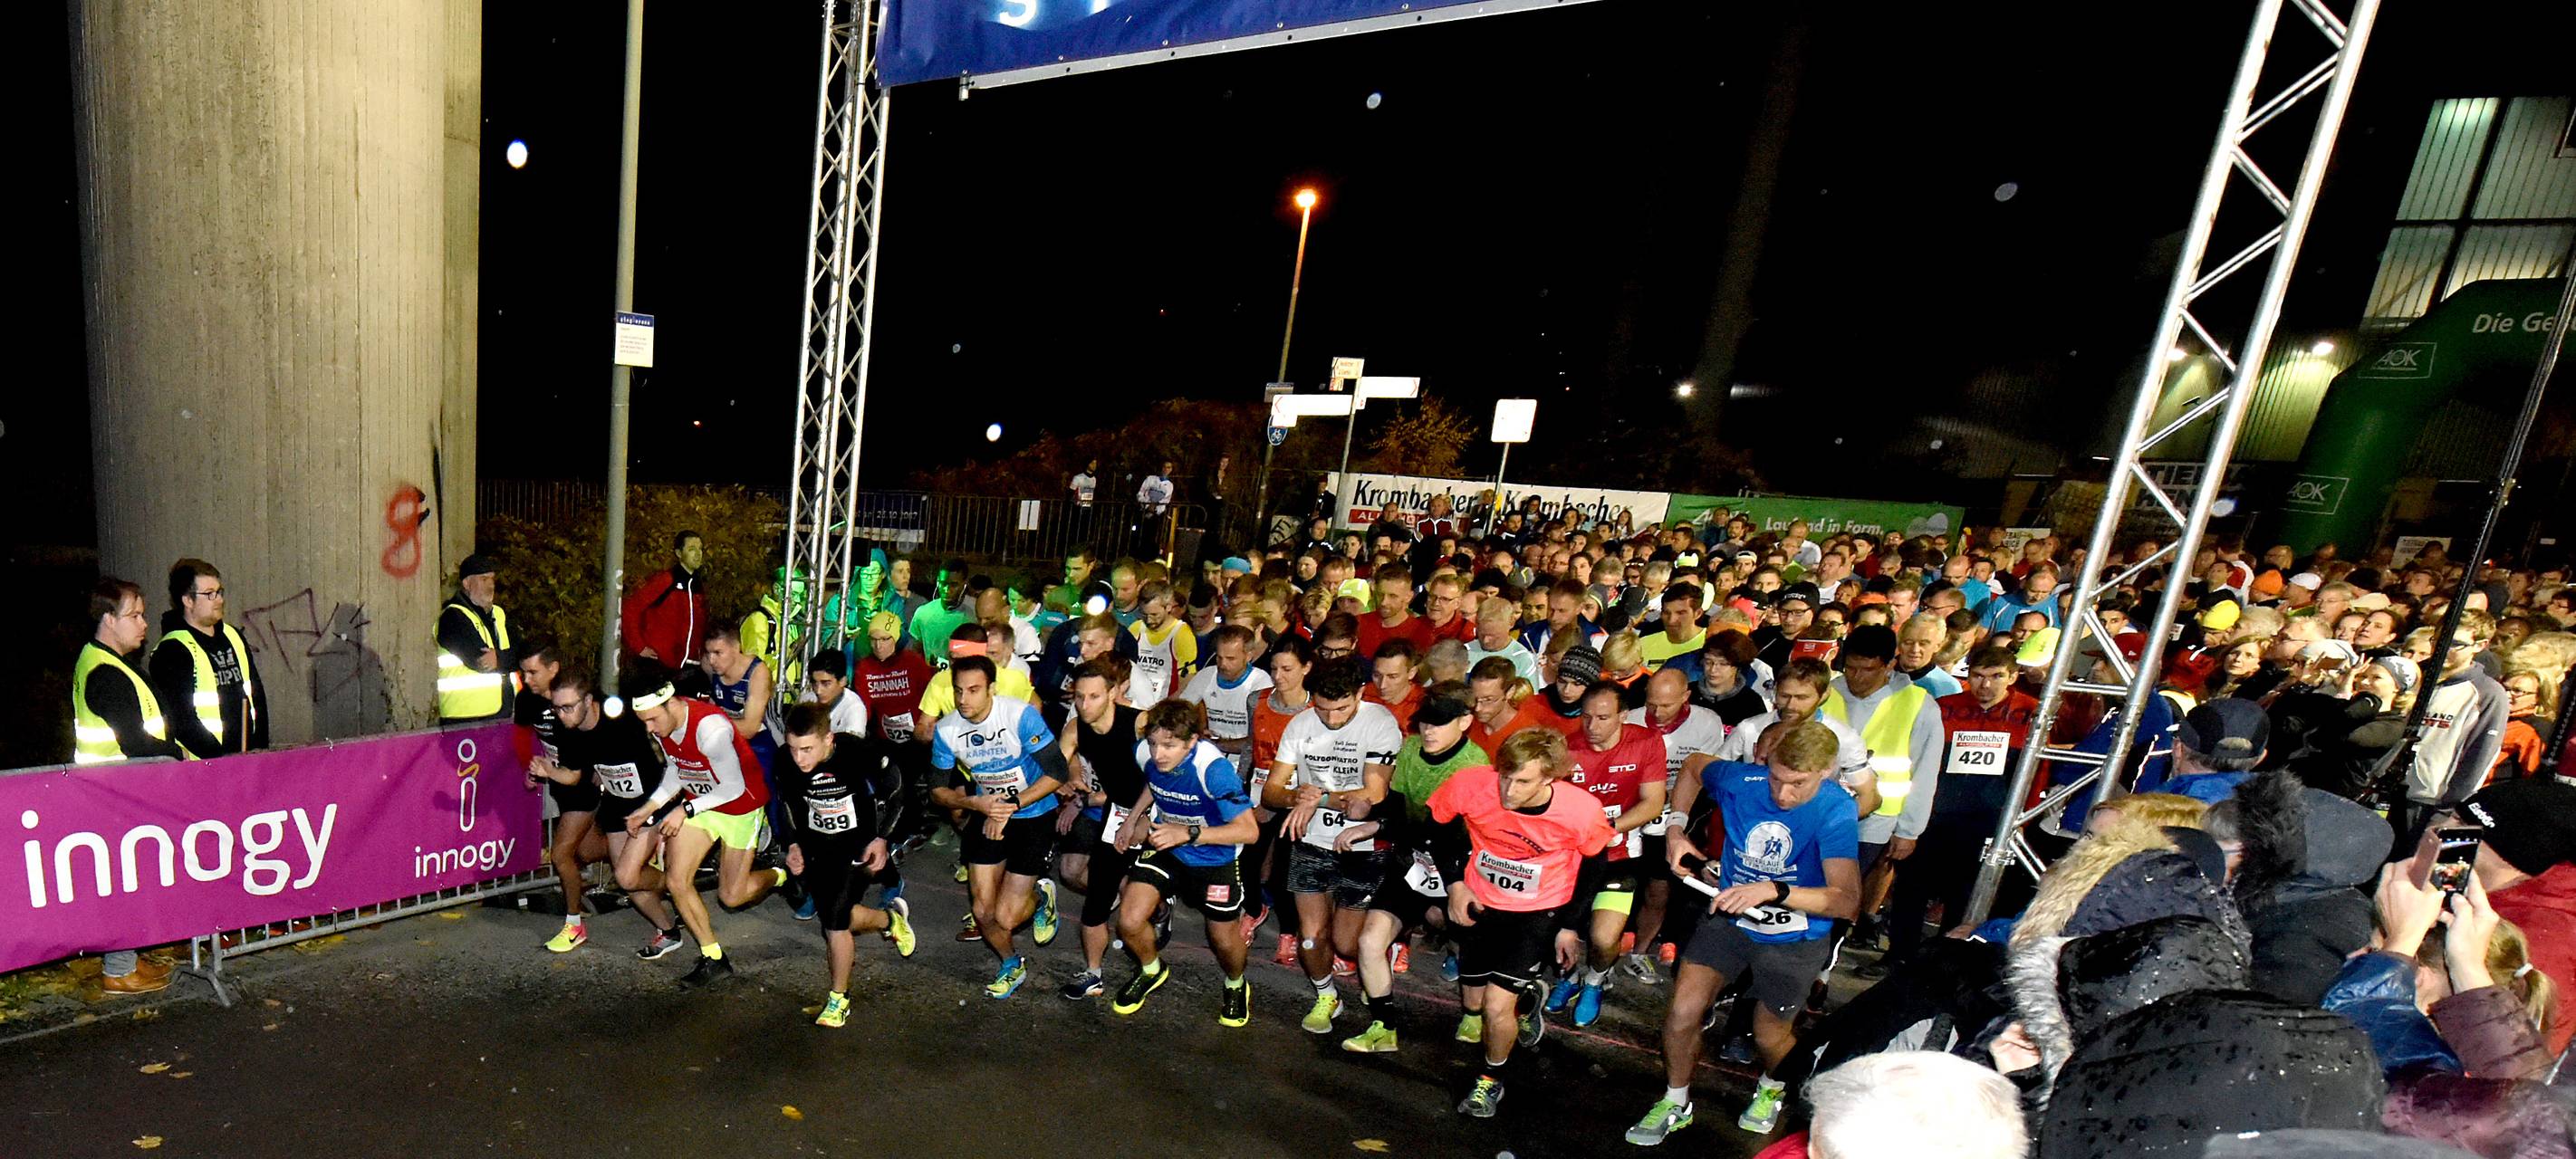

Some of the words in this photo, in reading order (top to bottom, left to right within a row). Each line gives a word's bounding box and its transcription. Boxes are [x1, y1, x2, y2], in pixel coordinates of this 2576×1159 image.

[2472, 313, 2514, 333] Die
[2374, 349, 2422, 367] AOK
[1828, 518, 1841, 532] in
[1845, 519, 1884, 535] Form.
[867, 676, 909, 693] SAVANNAH
[1956, 732, 2004, 742] Krombacher
[1958, 751, 1995, 766] 420
[608, 780, 634, 792] 112
[687, 782, 713, 795] 120
[812, 812, 851, 830] 589
[21, 803, 338, 907] innogy
[414, 837, 515, 878] innogy
[1481, 852, 1535, 876] Krombacher
[1486, 872, 1525, 893] 104
